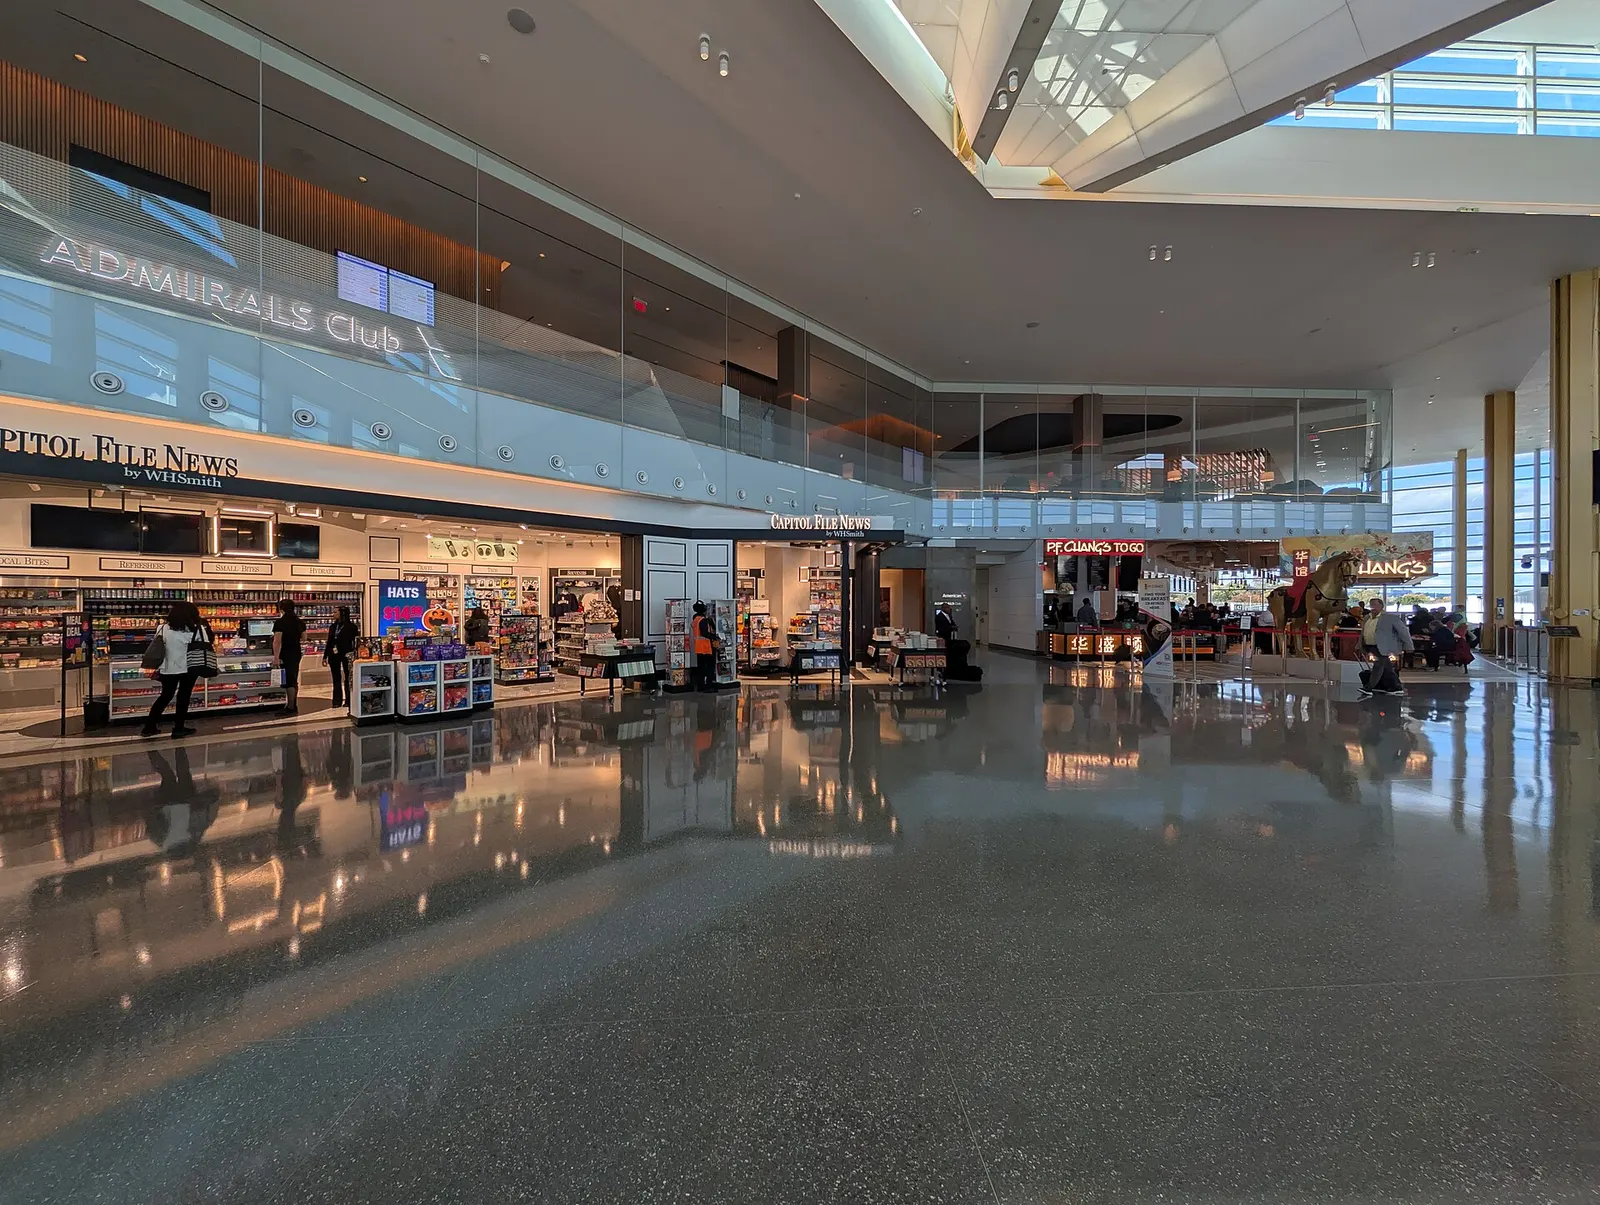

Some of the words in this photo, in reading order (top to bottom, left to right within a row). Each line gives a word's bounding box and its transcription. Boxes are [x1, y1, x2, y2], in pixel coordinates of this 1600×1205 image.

[39, 236, 314, 331] ADMIRALS
[326, 311, 401, 353] Club
[92, 434, 157, 468] FILE
[163, 444, 239, 477] NEWS
[124, 467, 141, 479] by
[143, 469, 222, 488] WHSmith
[771, 514, 813, 530] CAPITOL
[814, 514, 838, 530] FILE
[839, 514, 871, 530] NEWS
[1063, 540, 1112, 555] CHANG'S
[1113, 542, 1128, 553] TO
[1129, 542, 1144, 553] GO
[24, 557, 50, 566] BITES
[119, 560, 166, 570] REFRESHERS
[215, 564, 239, 572] SMALL
[241, 564, 260, 572] BITES
[387, 586, 420, 599] HATS
[66, 615, 82, 626] MEAL
[66, 627, 82, 637] DEAL
